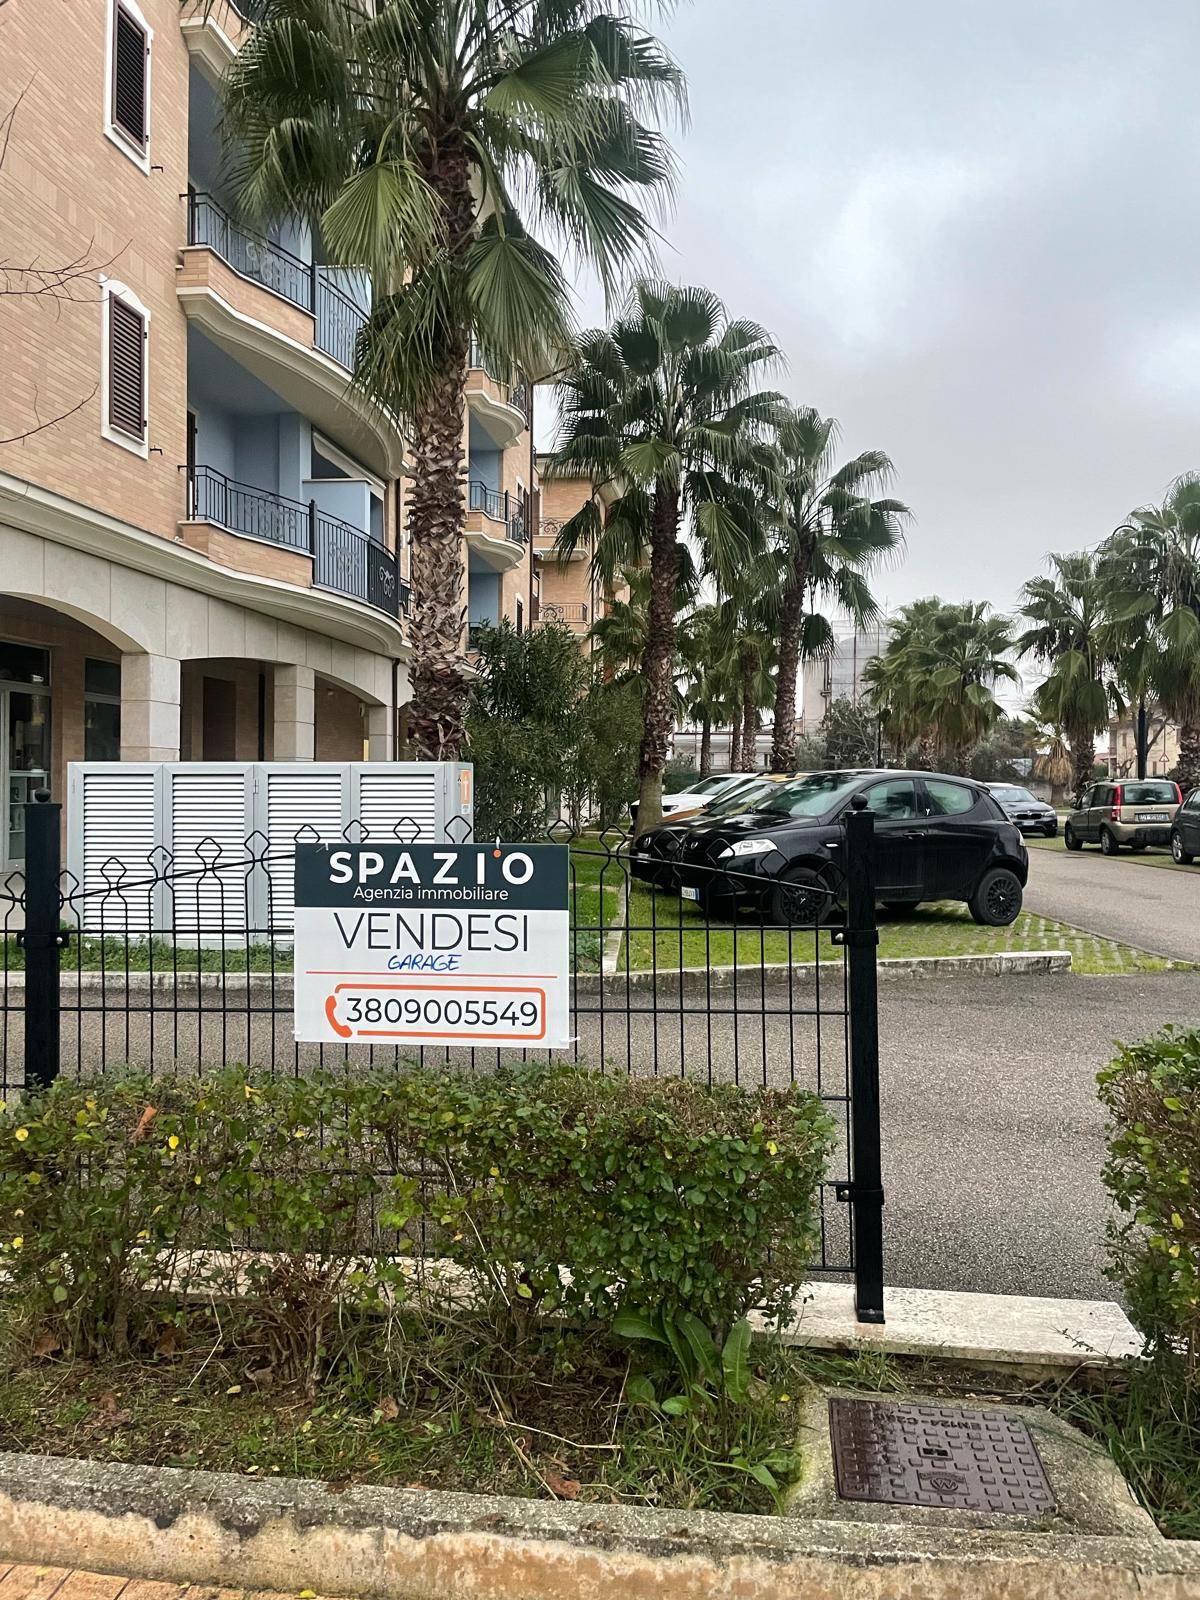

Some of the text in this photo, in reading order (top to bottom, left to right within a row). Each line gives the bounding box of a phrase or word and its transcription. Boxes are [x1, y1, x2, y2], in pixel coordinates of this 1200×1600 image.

[330, 852, 533, 884] SPAZIO
[353, 886, 508, 901] Agenzia immobiliare
[334, 913, 527, 951] VENDESI
[388, 954, 461, 971] GARAGE
[346, 998, 538, 1027] 3809005549
